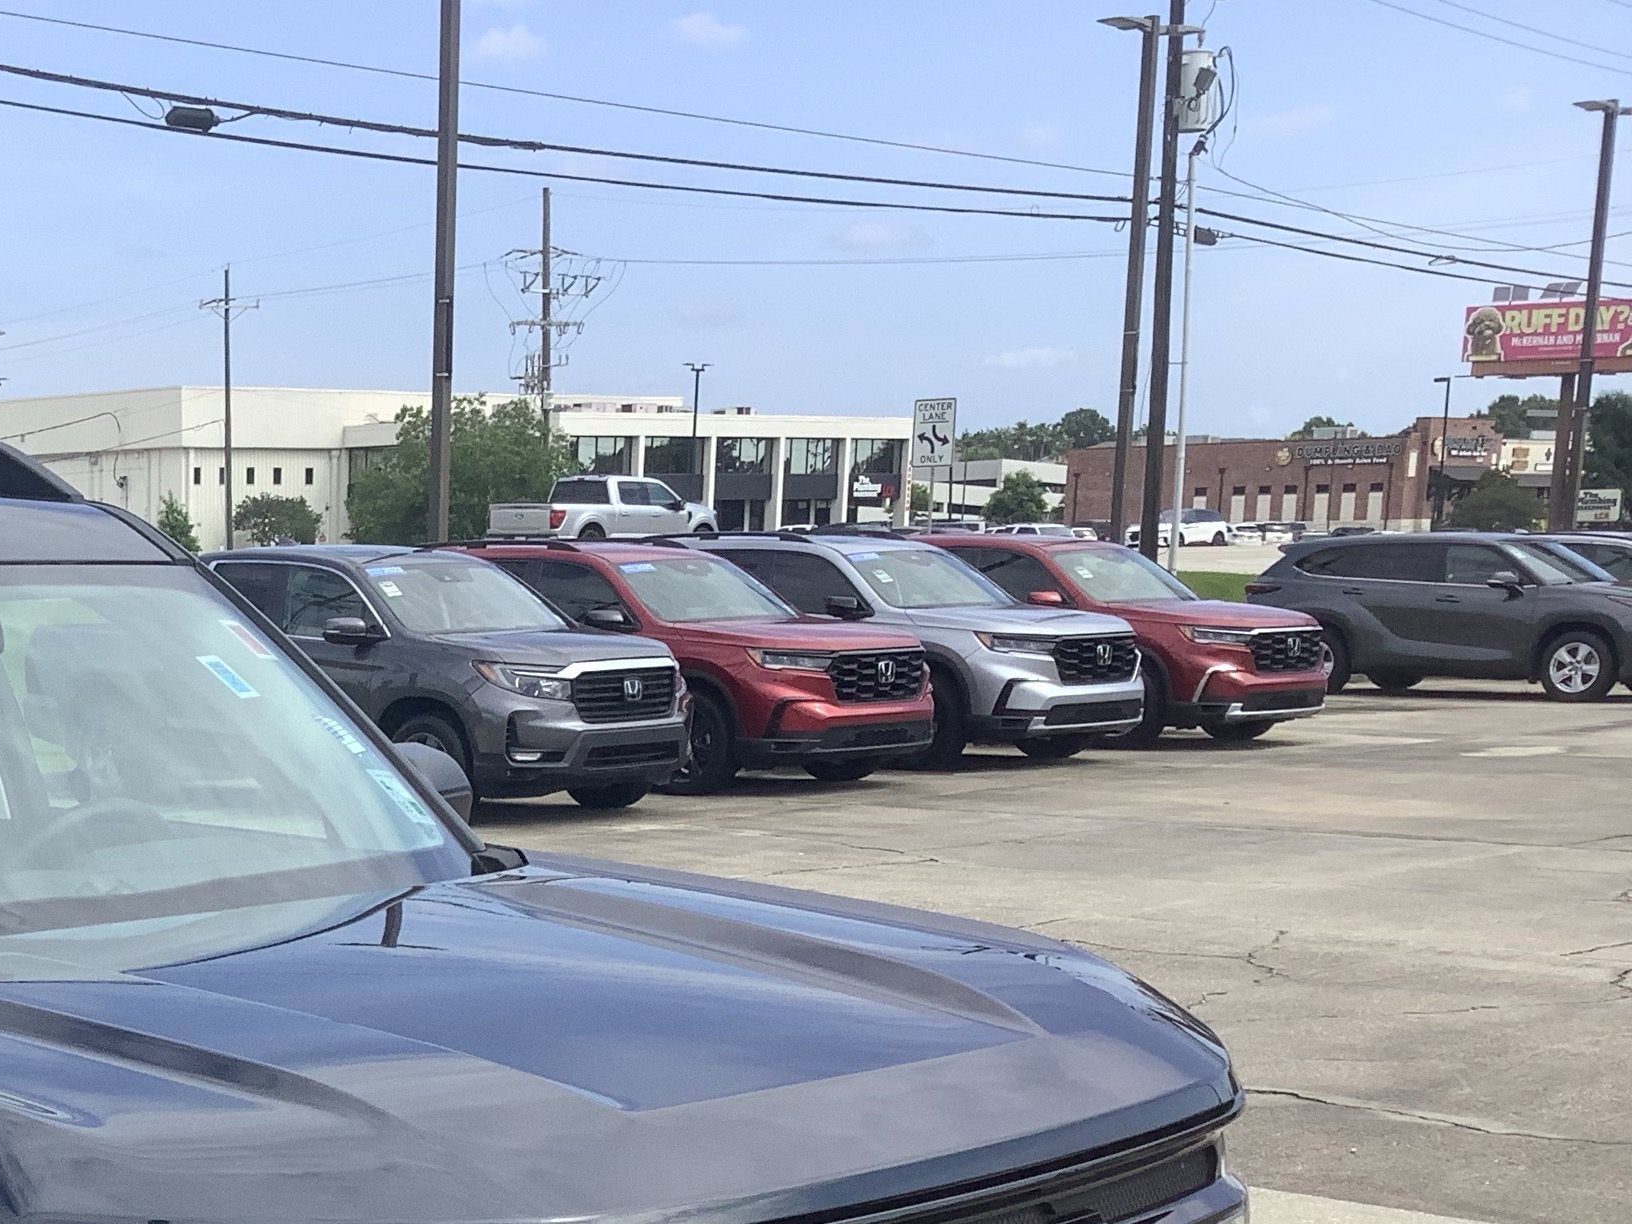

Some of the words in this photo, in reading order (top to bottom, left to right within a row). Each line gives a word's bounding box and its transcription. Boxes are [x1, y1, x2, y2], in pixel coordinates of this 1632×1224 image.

[1504, 308, 1567, 334] RUFF
[918, 402, 953, 412] CENTER
[923, 412, 947, 421] LANE
[1296, 444, 1360, 458] DUMPLING
[1376, 443, 1402, 456] BAO
[920, 455, 945, 464] ONLY
